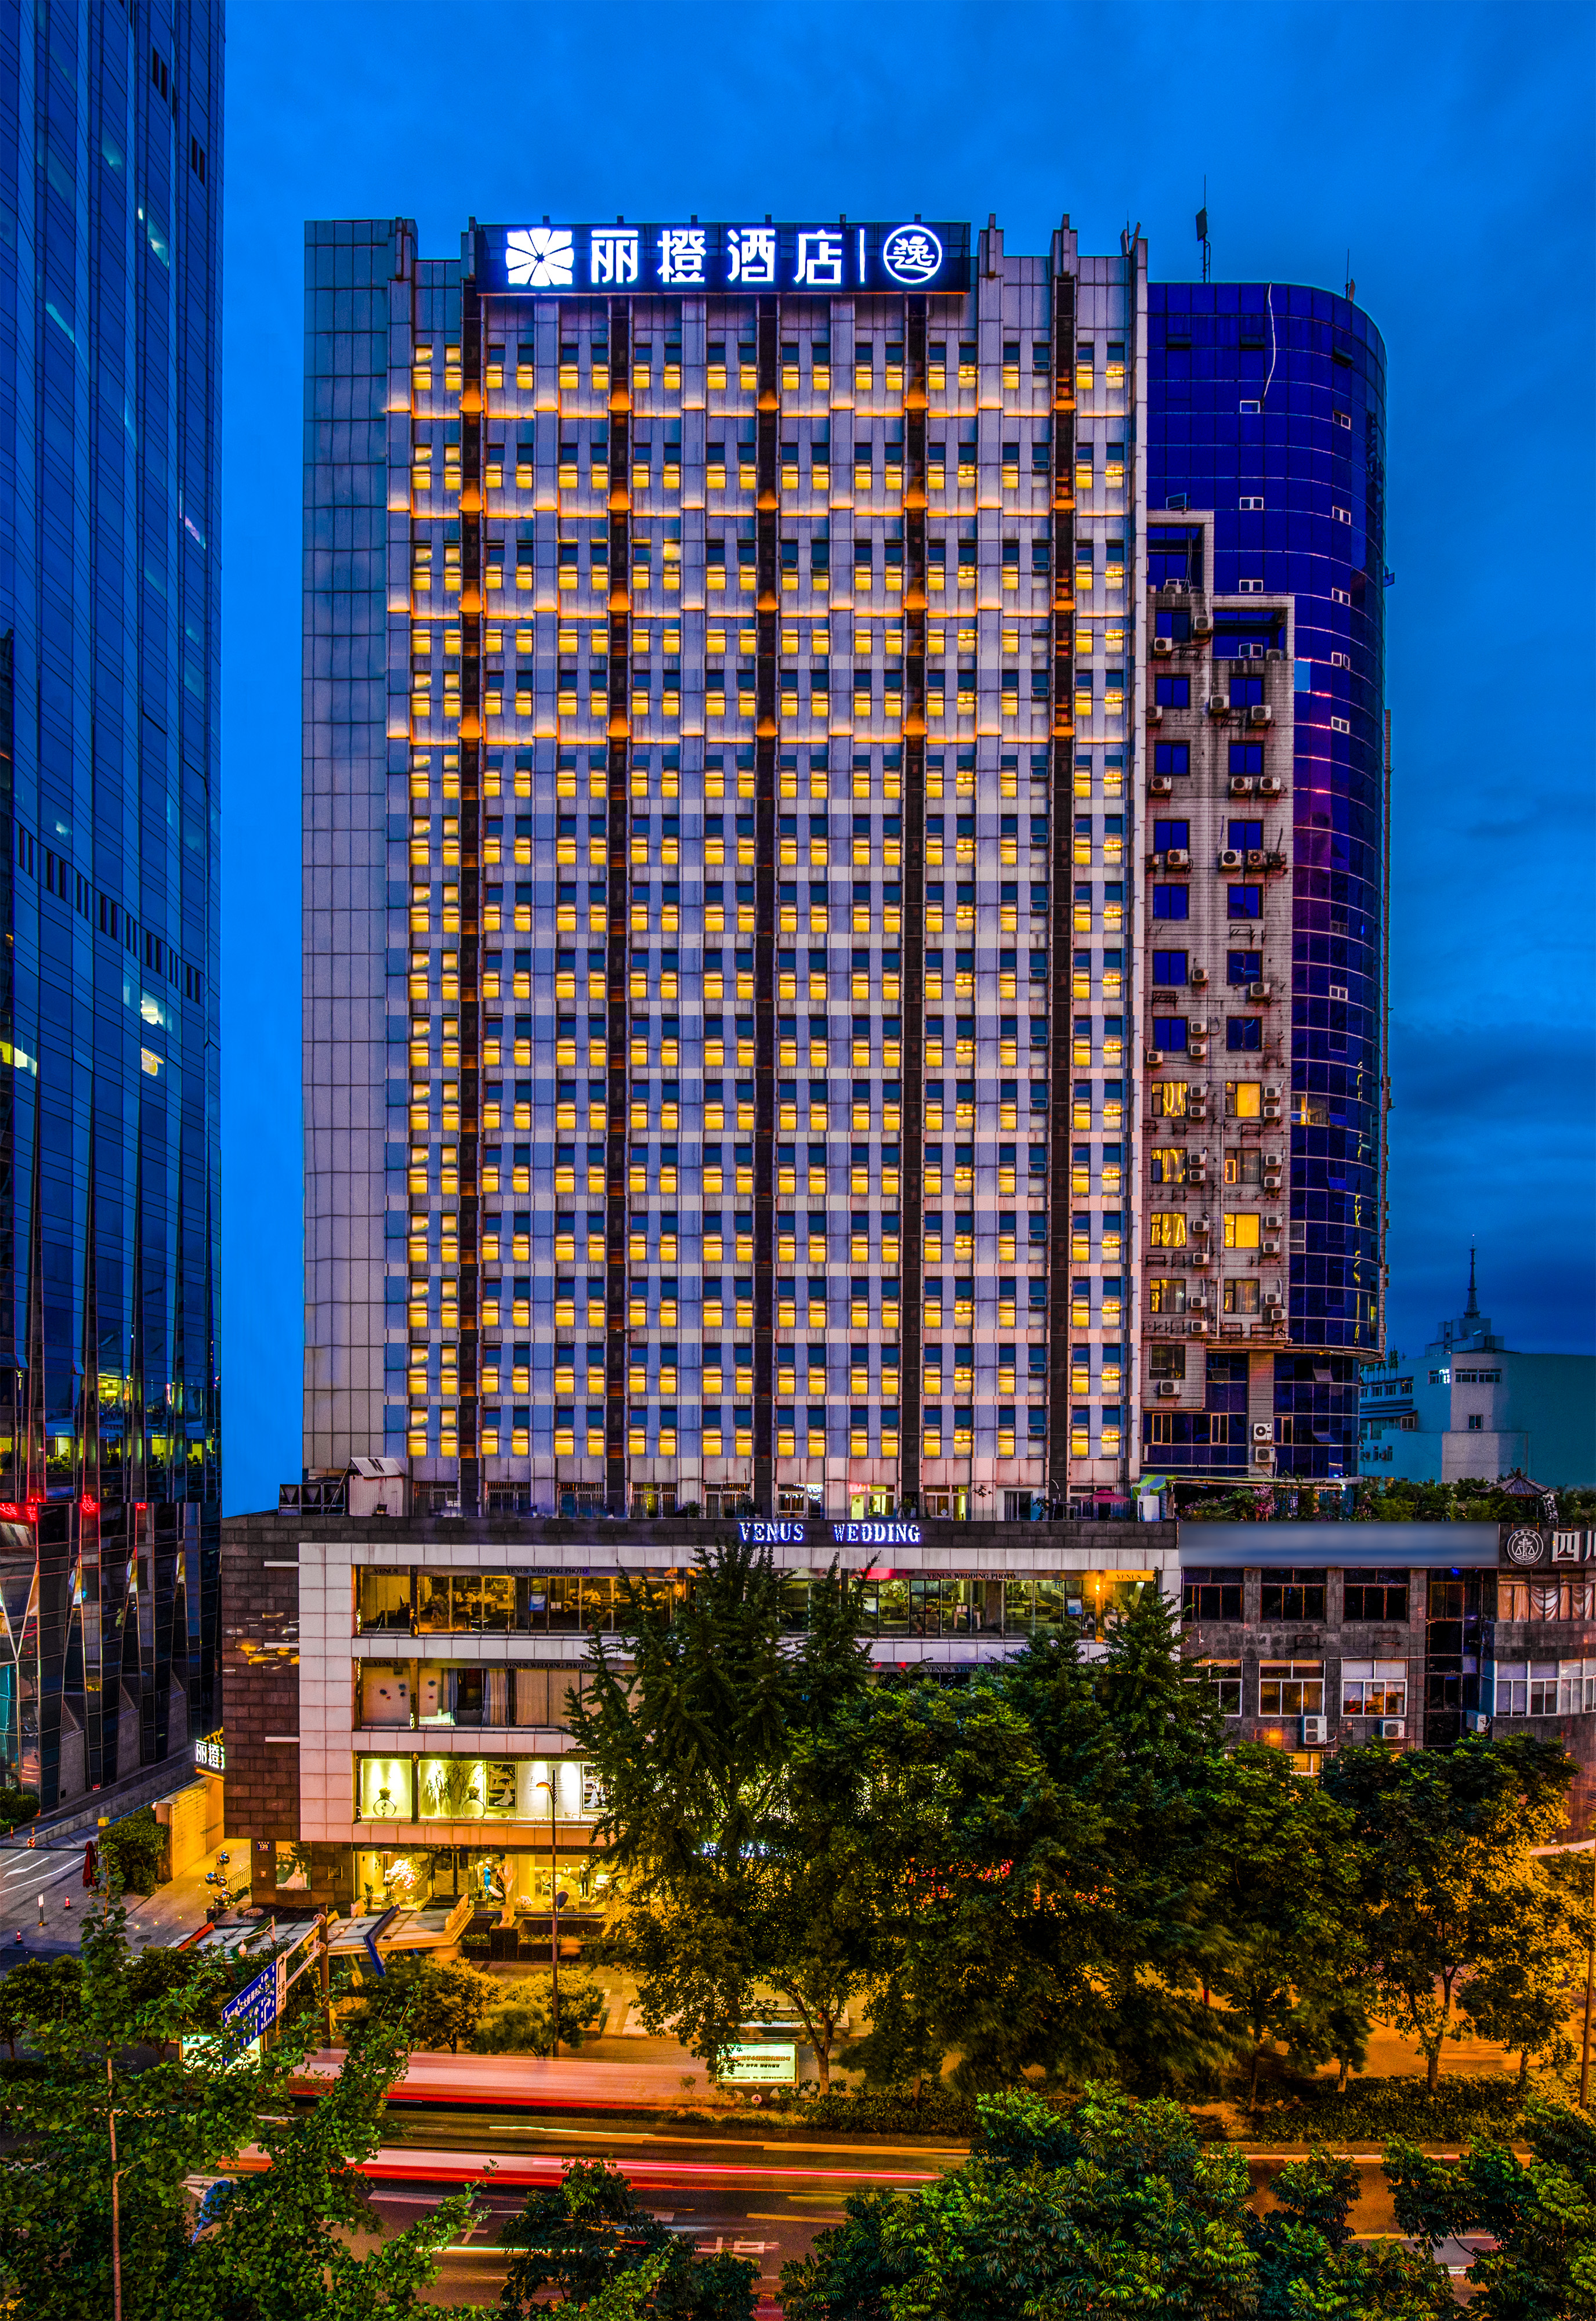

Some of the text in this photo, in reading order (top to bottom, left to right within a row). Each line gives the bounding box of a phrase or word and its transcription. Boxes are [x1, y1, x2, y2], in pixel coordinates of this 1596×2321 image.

[591, 229, 842, 284] 丽橙酒店
[739, 1523, 921, 1542] VENUS WEDDING
